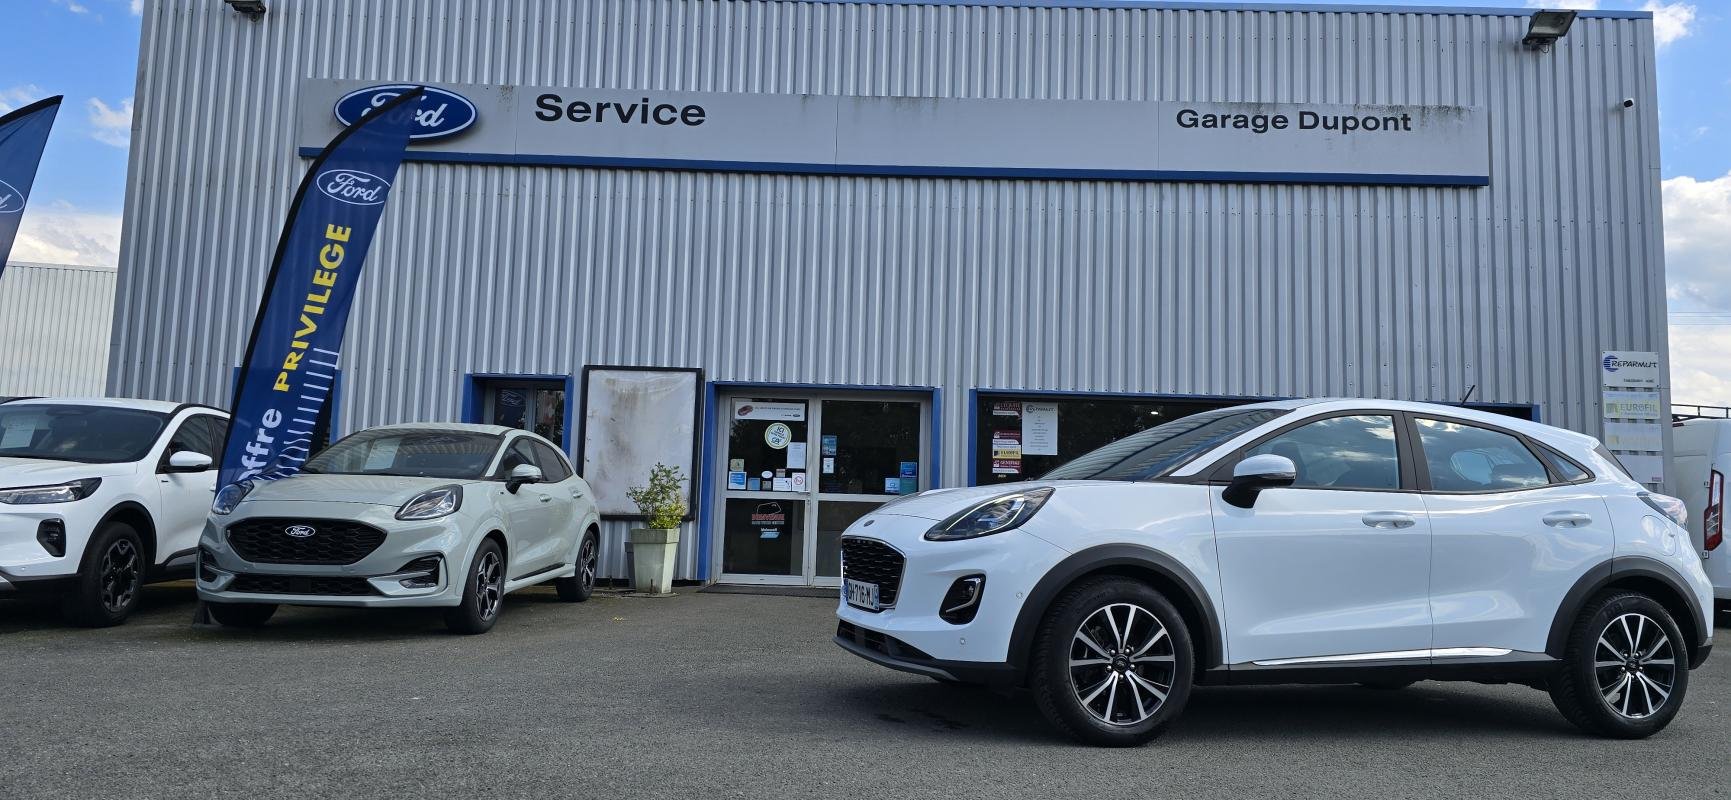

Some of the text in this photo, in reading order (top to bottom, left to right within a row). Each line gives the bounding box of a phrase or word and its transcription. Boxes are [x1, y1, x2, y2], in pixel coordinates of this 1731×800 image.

[535, 93, 706, 127] Service
[1176, 109, 1412, 135] Garage Dupont
[326, 172, 383, 202] Ford
[272, 222, 352, 393] PRIVILEGE
[1611, 360, 1658, 369] REPARMUT
